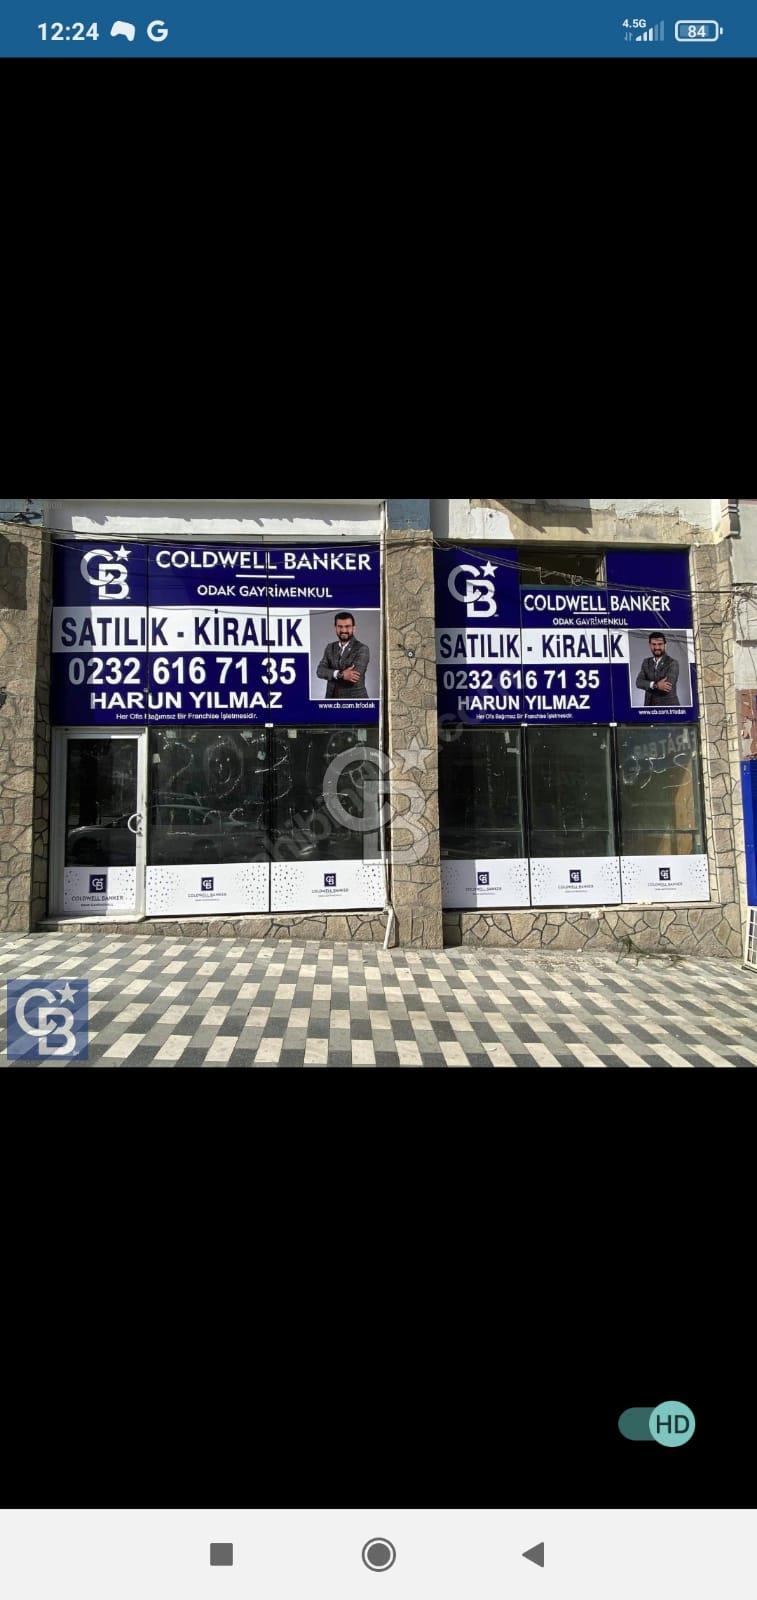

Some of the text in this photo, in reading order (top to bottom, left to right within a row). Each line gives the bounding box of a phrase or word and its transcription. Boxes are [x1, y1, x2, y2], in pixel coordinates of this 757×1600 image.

[37, 22, 99, 42] 12:24
[622, 18, 646, 28] 4.5G
[687, 25, 706, 39] 84
[156, 550, 371, 571] COLDWELL BANKER
[197, 584, 332, 598] ODAK GAYRİMENKUL
[523, 595, 670, 612] COLDWELL BANKER
[61, 616, 169, 647] SATILIK
[552, 617, 574, 627] ODAK
[440, 633, 520, 658] SATILIK
[69, 657, 296, 685] 0232 616 71 35
[443, 670, 600, 690] 0232 616 71 35
[90, 691, 283, 709] HARUN YILMAZ
[458, 694, 591, 711] HARUN YILMAZ
[656, 1414, 690, 1434] HD
